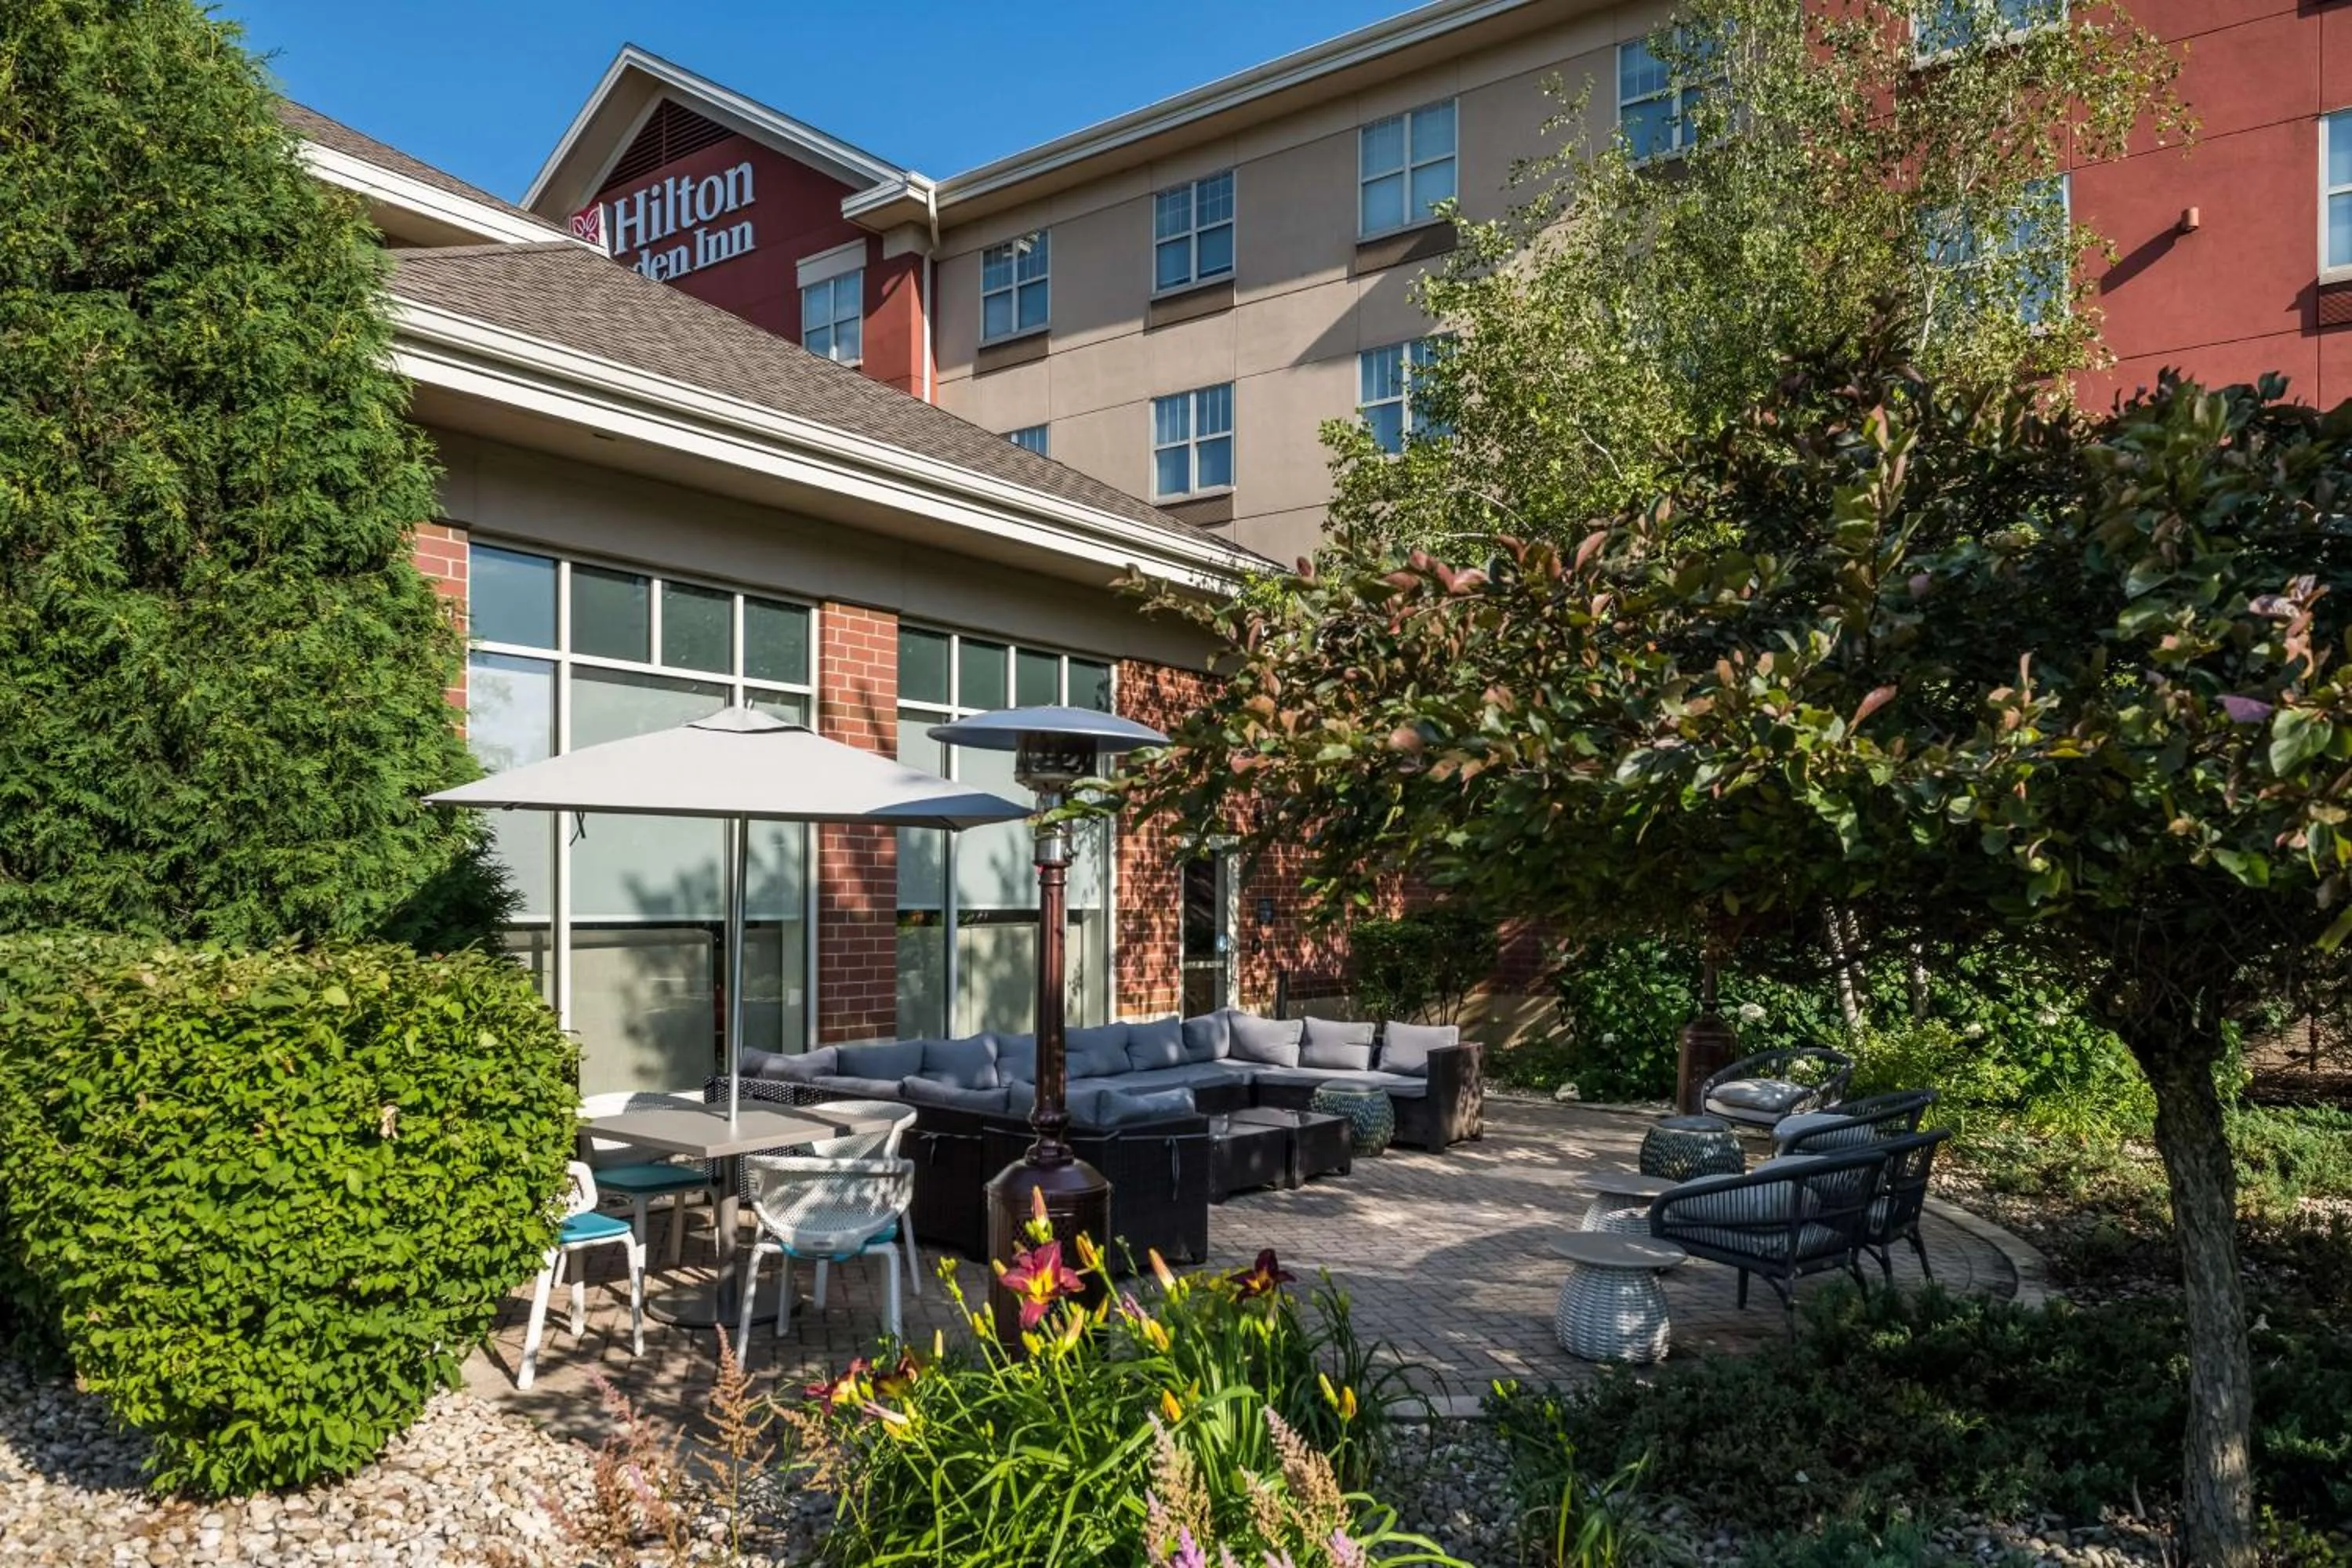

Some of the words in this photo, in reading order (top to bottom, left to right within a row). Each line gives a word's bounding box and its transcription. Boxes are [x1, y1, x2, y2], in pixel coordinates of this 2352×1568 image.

[614, 162, 755, 256] Hilton
[629, 244, 691, 282] den
[693, 220, 756, 270] Inn
